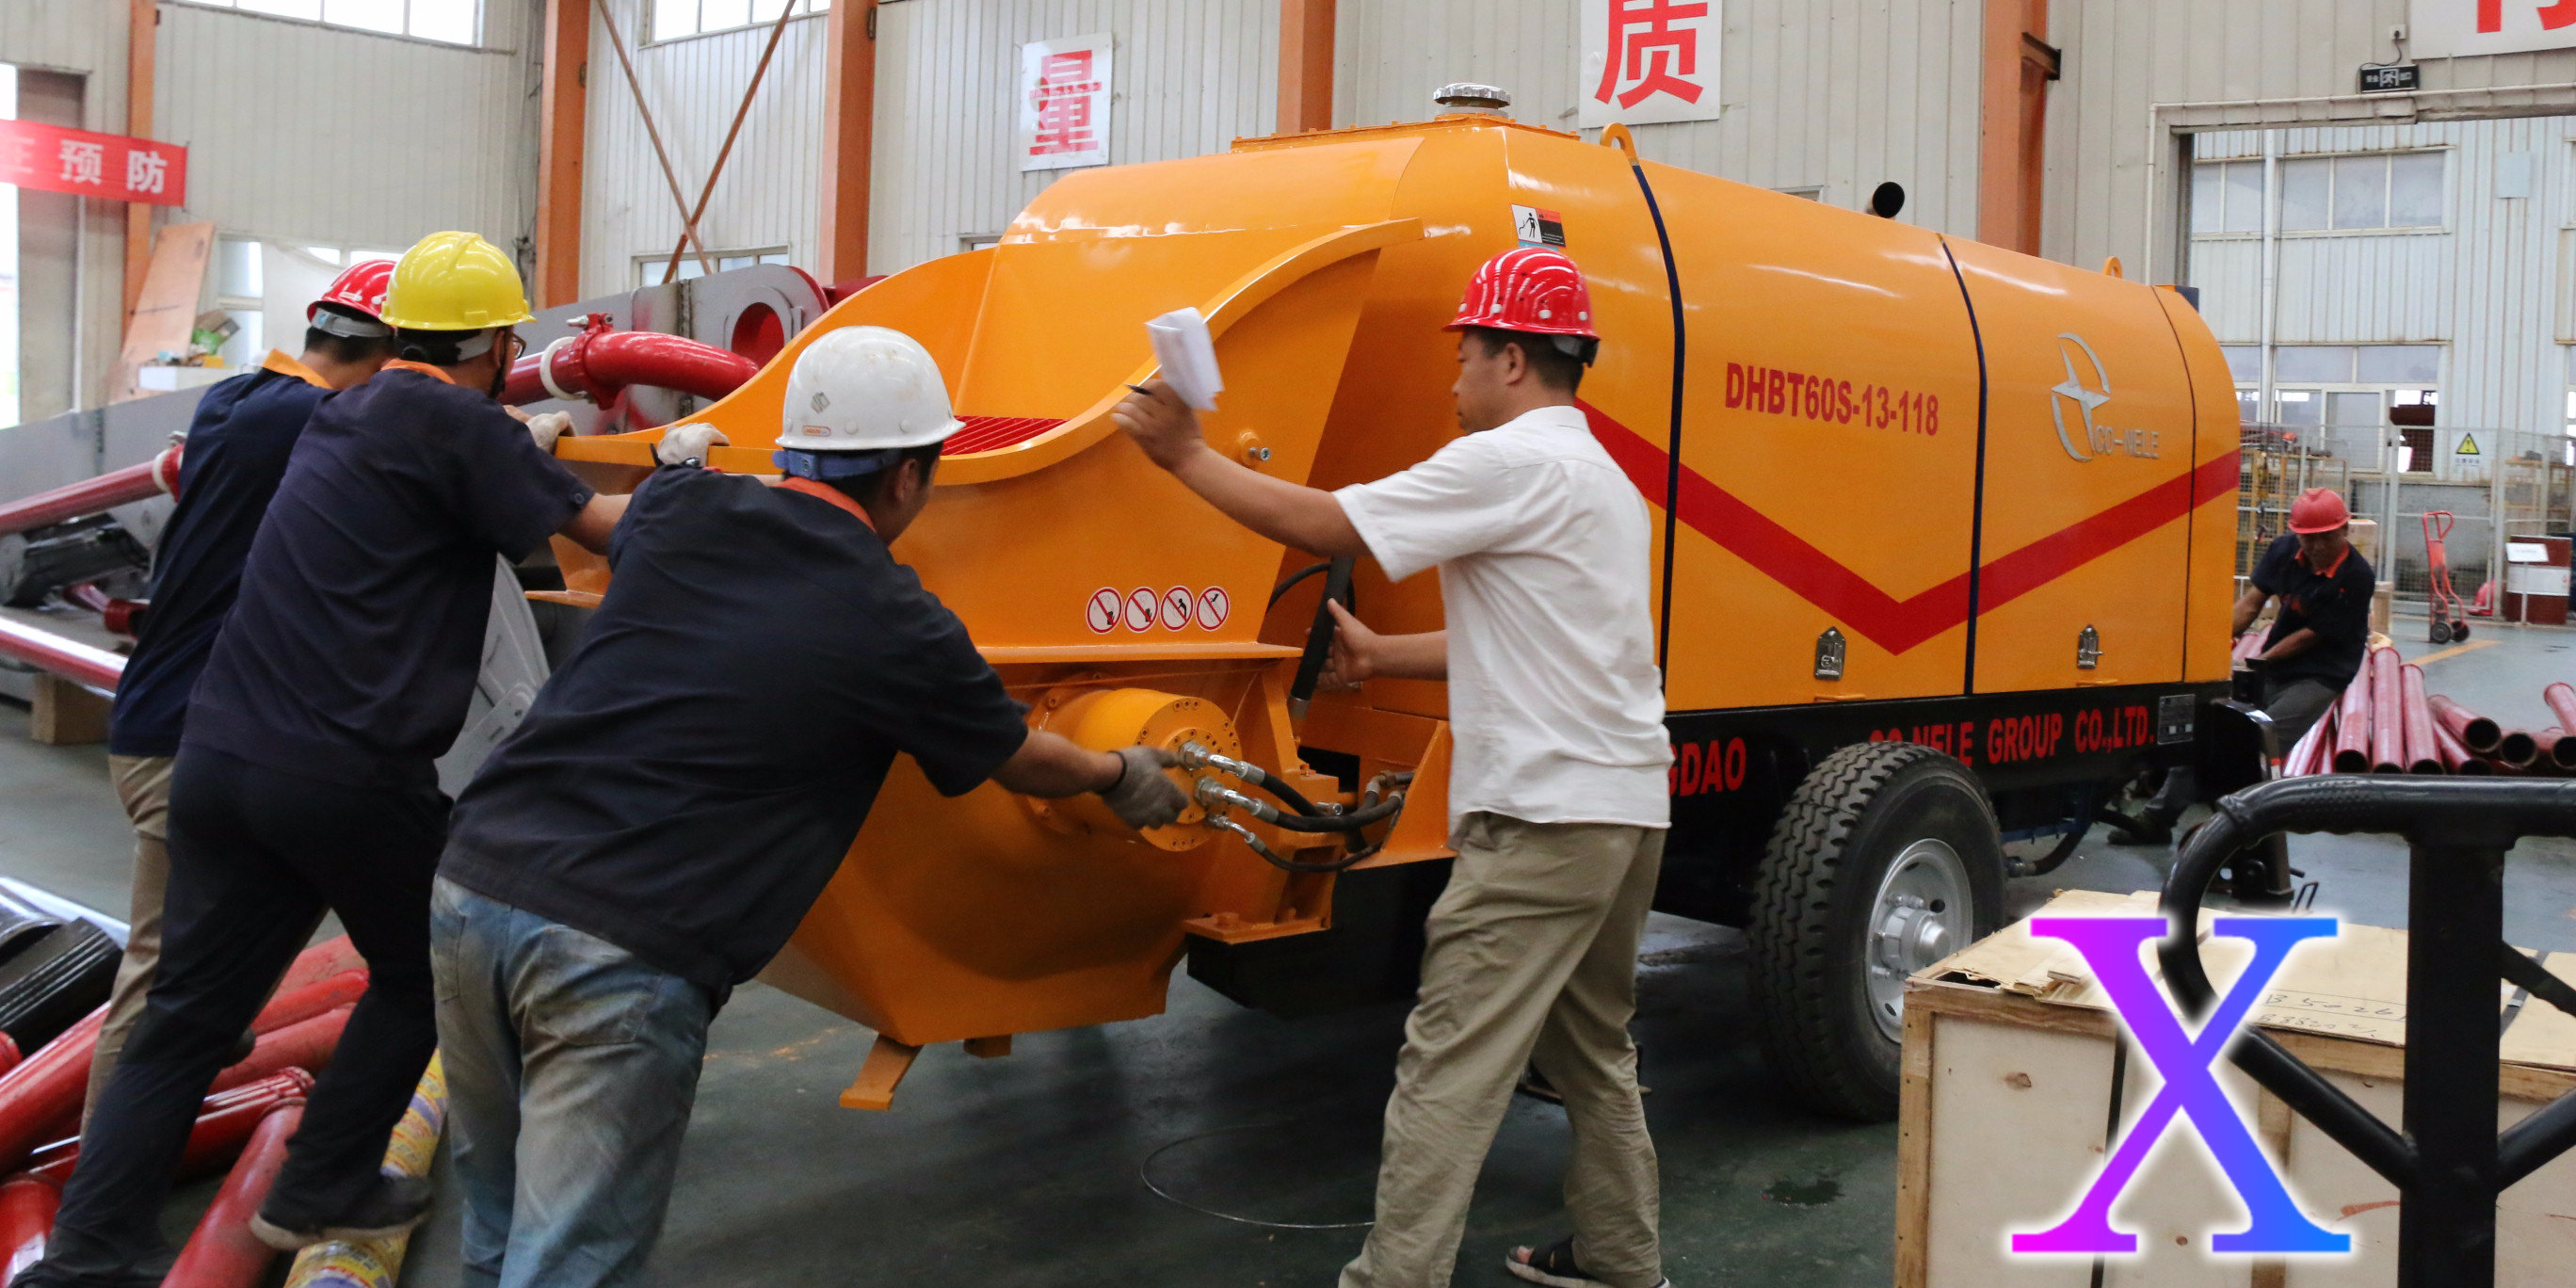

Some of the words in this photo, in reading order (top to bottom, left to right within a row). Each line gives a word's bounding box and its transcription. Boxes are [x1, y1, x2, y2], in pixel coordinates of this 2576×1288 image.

[1594, 0, 1709, 110] 质
[1029, 50, 1103, 156] 量
[1725, 362, 1940, 437] DHBT60S-13-118
[2094, 425, 2160, 459] CO-NELE
[1987, 713, 2064, 765] GROUP
[2074, 705, 2155, 753] CO.,LTD.
